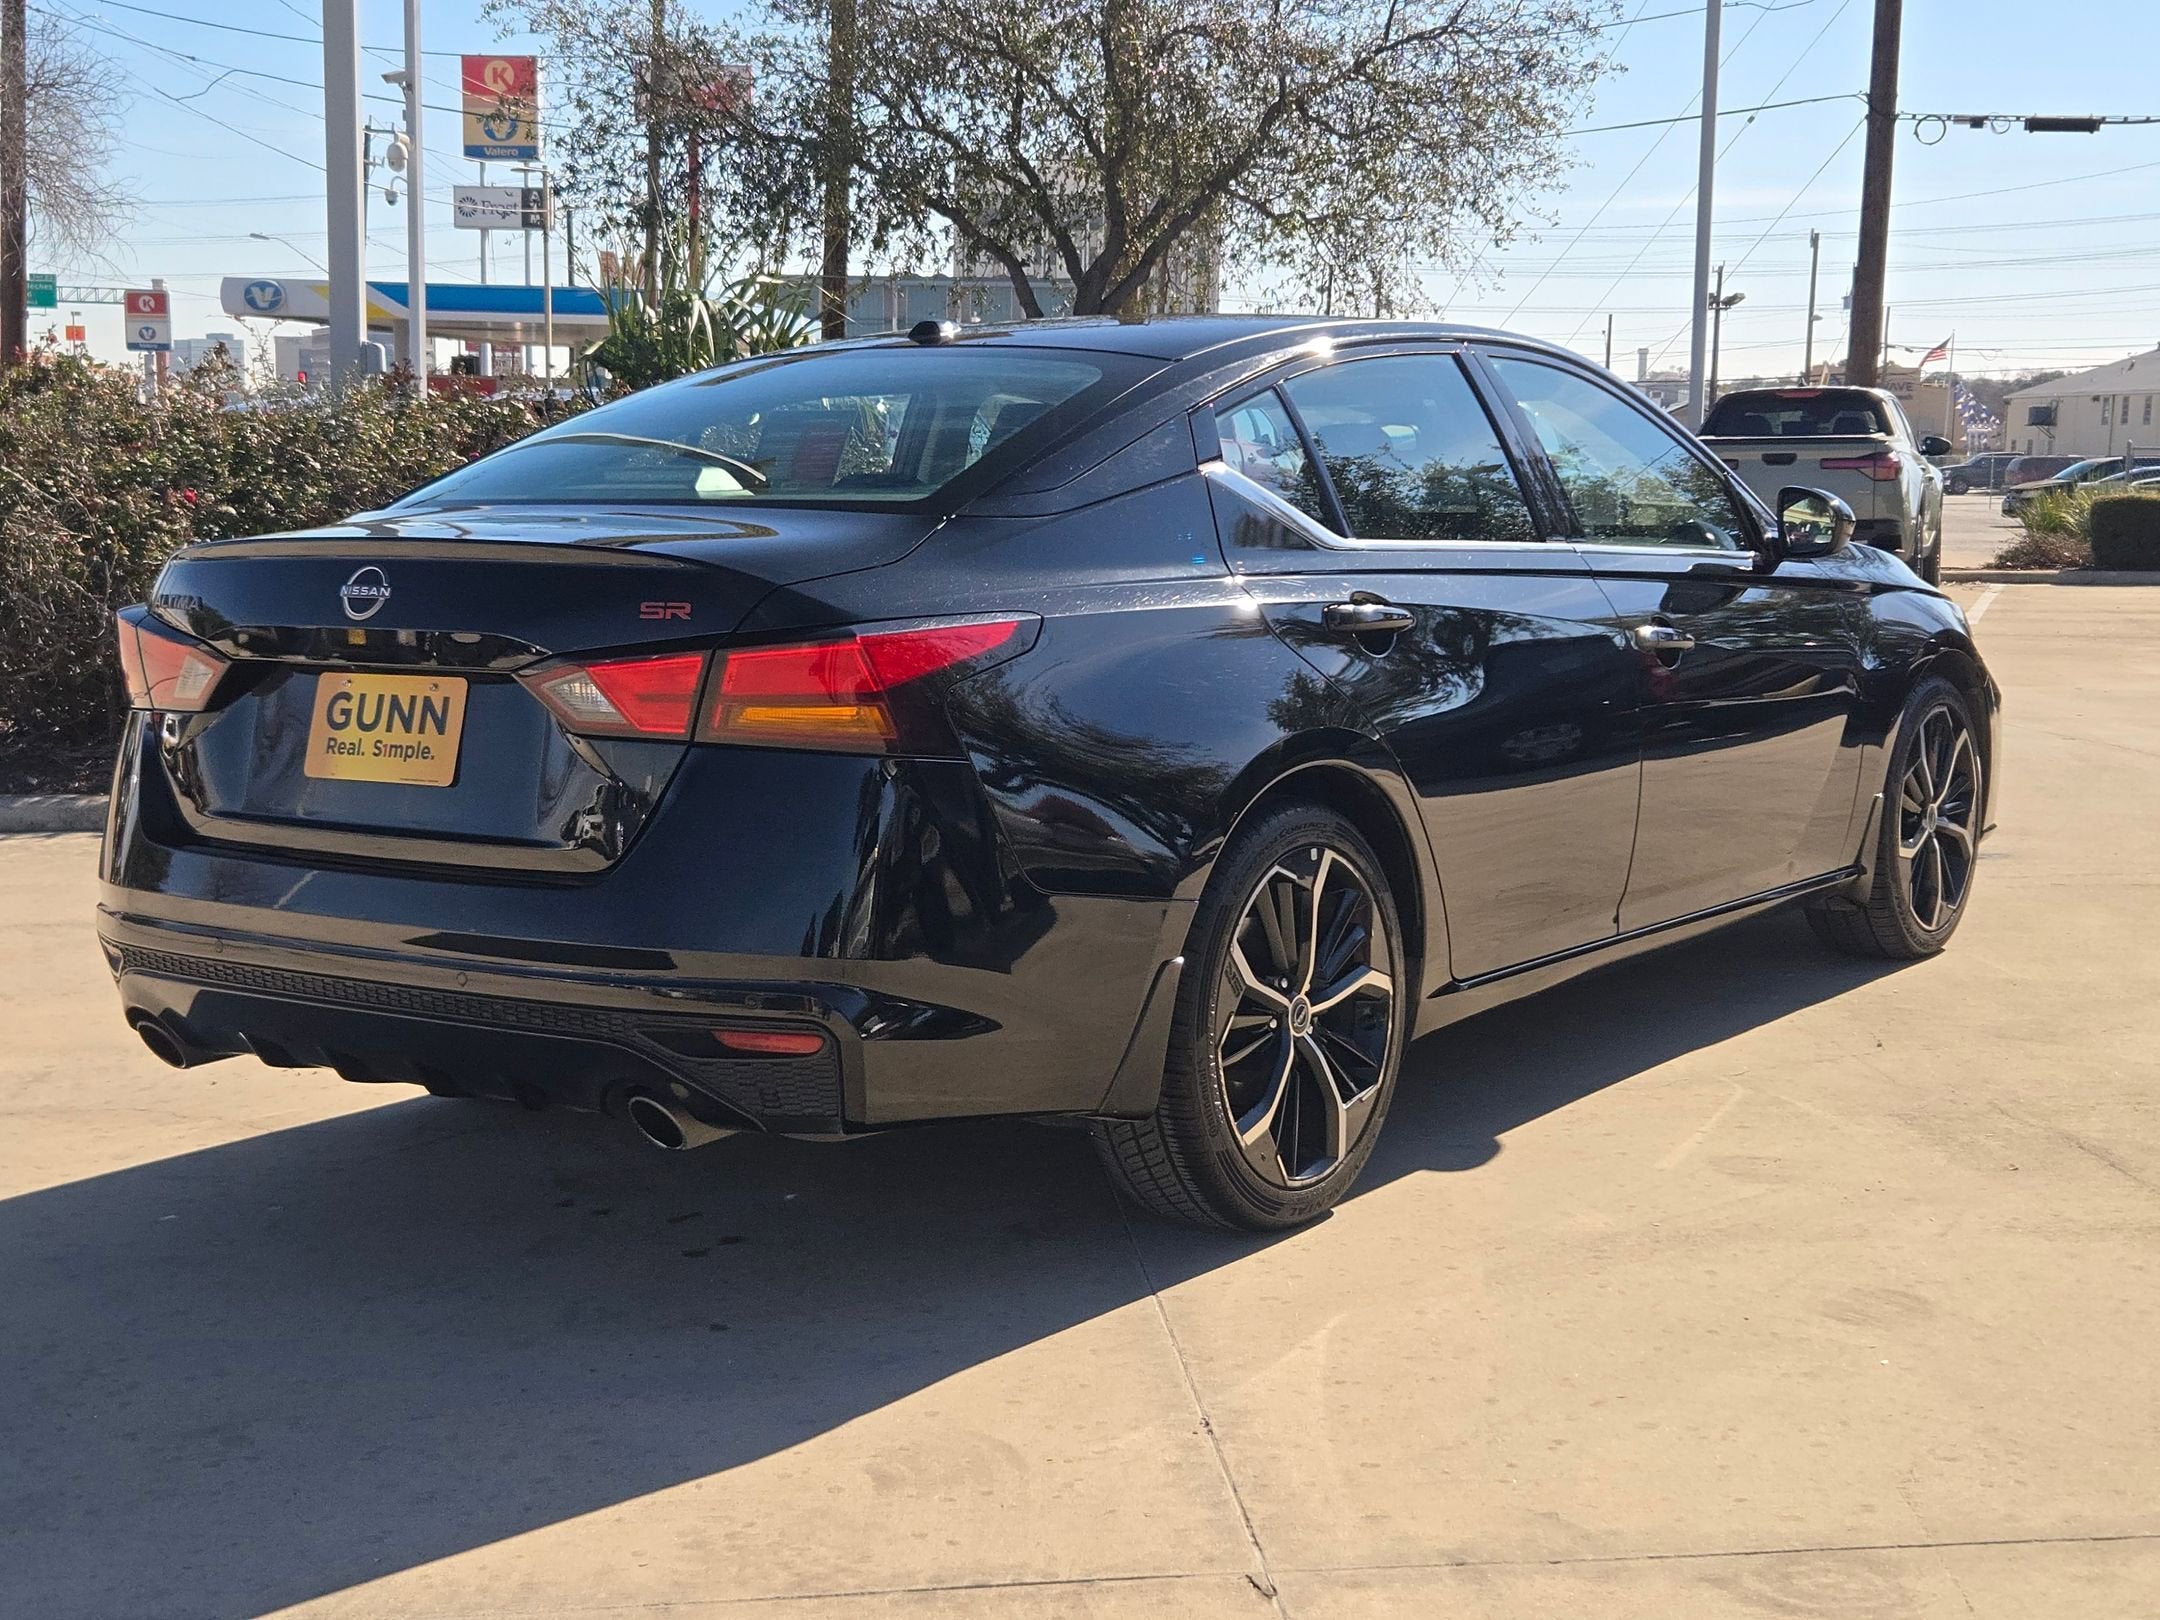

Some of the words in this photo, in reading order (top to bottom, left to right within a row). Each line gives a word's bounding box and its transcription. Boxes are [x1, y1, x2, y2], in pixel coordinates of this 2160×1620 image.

[484, 147, 519, 157] Valero
[340, 585, 391, 597] NISSAN
[155, 595, 202, 610] ALTIMA
[640, 602, 692, 620] SR
[326, 691, 451, 735] GUNN
[326, 737, 365, 756] Real.
